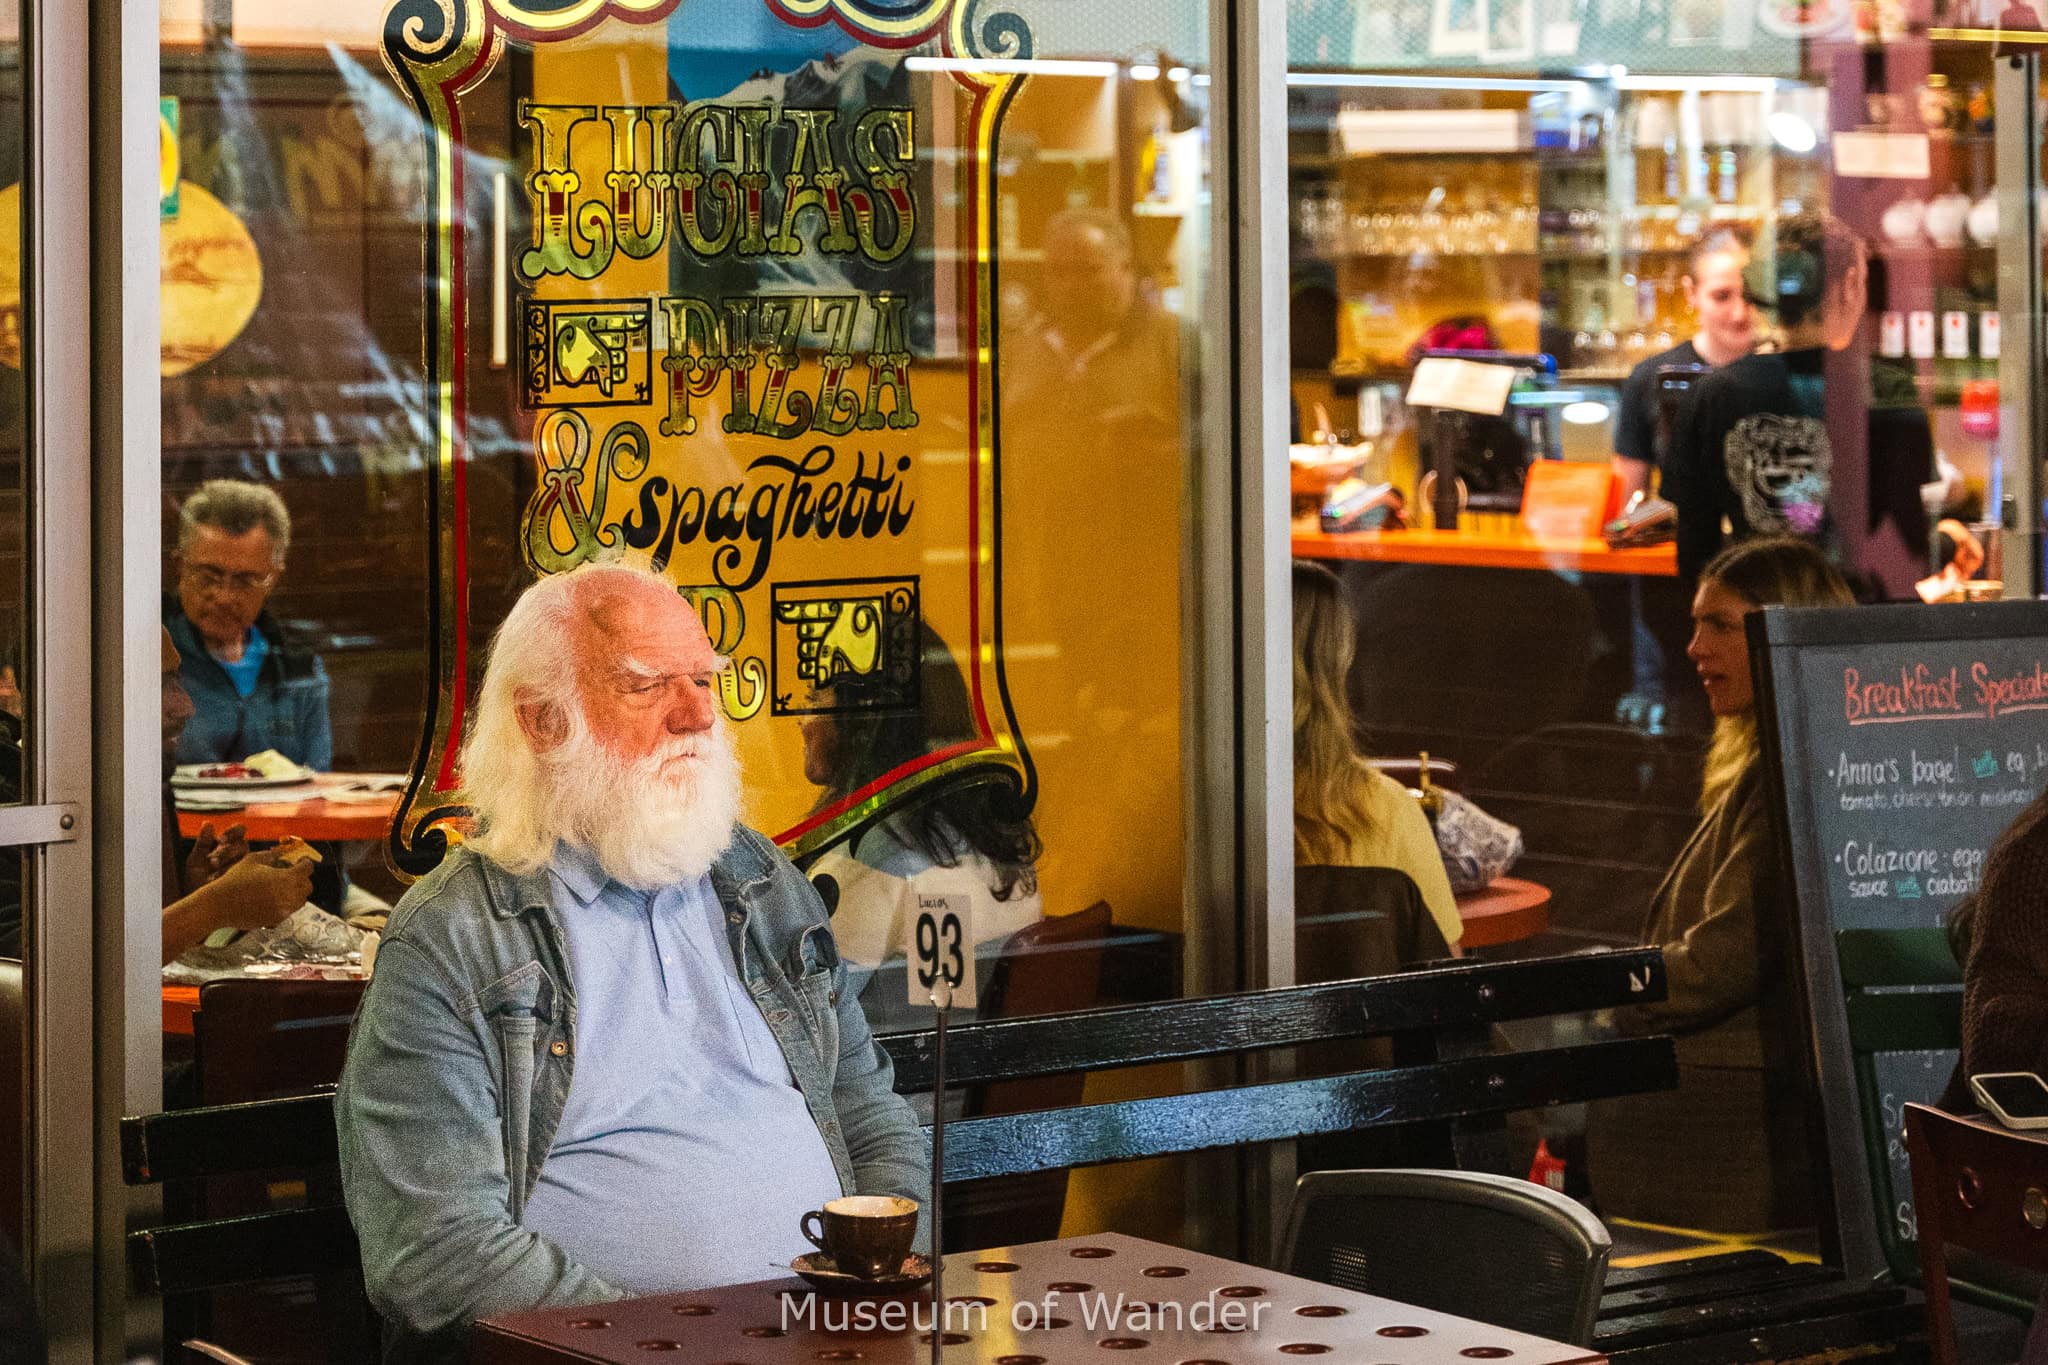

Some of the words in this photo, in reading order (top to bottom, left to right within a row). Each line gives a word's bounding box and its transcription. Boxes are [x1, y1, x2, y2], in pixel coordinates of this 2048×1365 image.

[520, 104, 917, 281] LUCIAS
[658, 295, 920, 441] PIZZA
[525, 408, 650, 576] &
[622, 445, 915, 592] spaghetti
[1844, 663, 1962, 721] Breakfast
[1838, 750, 1900, 788] Anna's
[1911, 746, 1959, 788] bagel
[1848, 879, 1889, 898] sauce
[916, 912, 964, 989] 93
